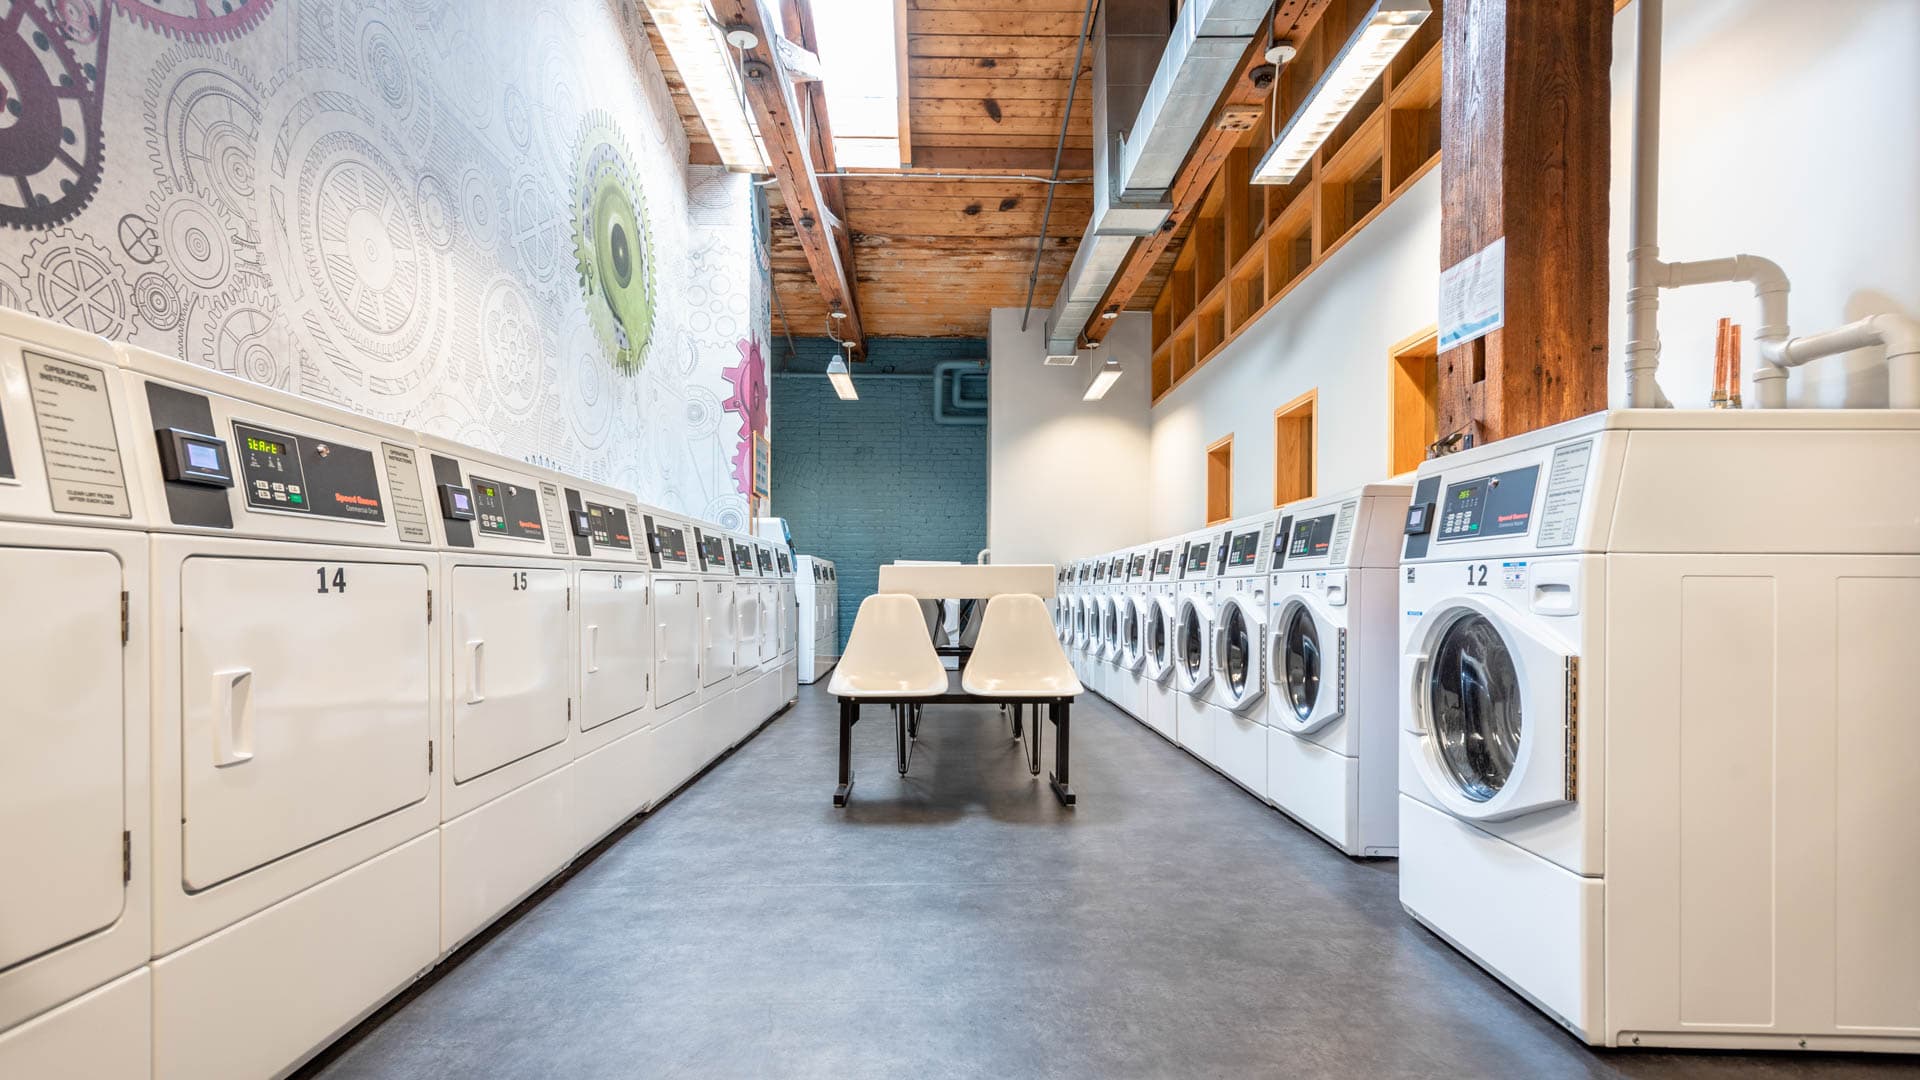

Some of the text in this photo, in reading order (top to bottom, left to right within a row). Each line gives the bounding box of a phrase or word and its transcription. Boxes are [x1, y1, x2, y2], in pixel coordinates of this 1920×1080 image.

[43, 364, 90, 381] OPERATING
[39, 372, 98, 392] INSTRUCTIONS
[317, 567, 346, 593] 14
[513, 572, 527, 590] 15
[613, 574, 622, 589] 16
[1301, 574, 1310, 588] 11
[1467, 564, 1488, 586] 12
